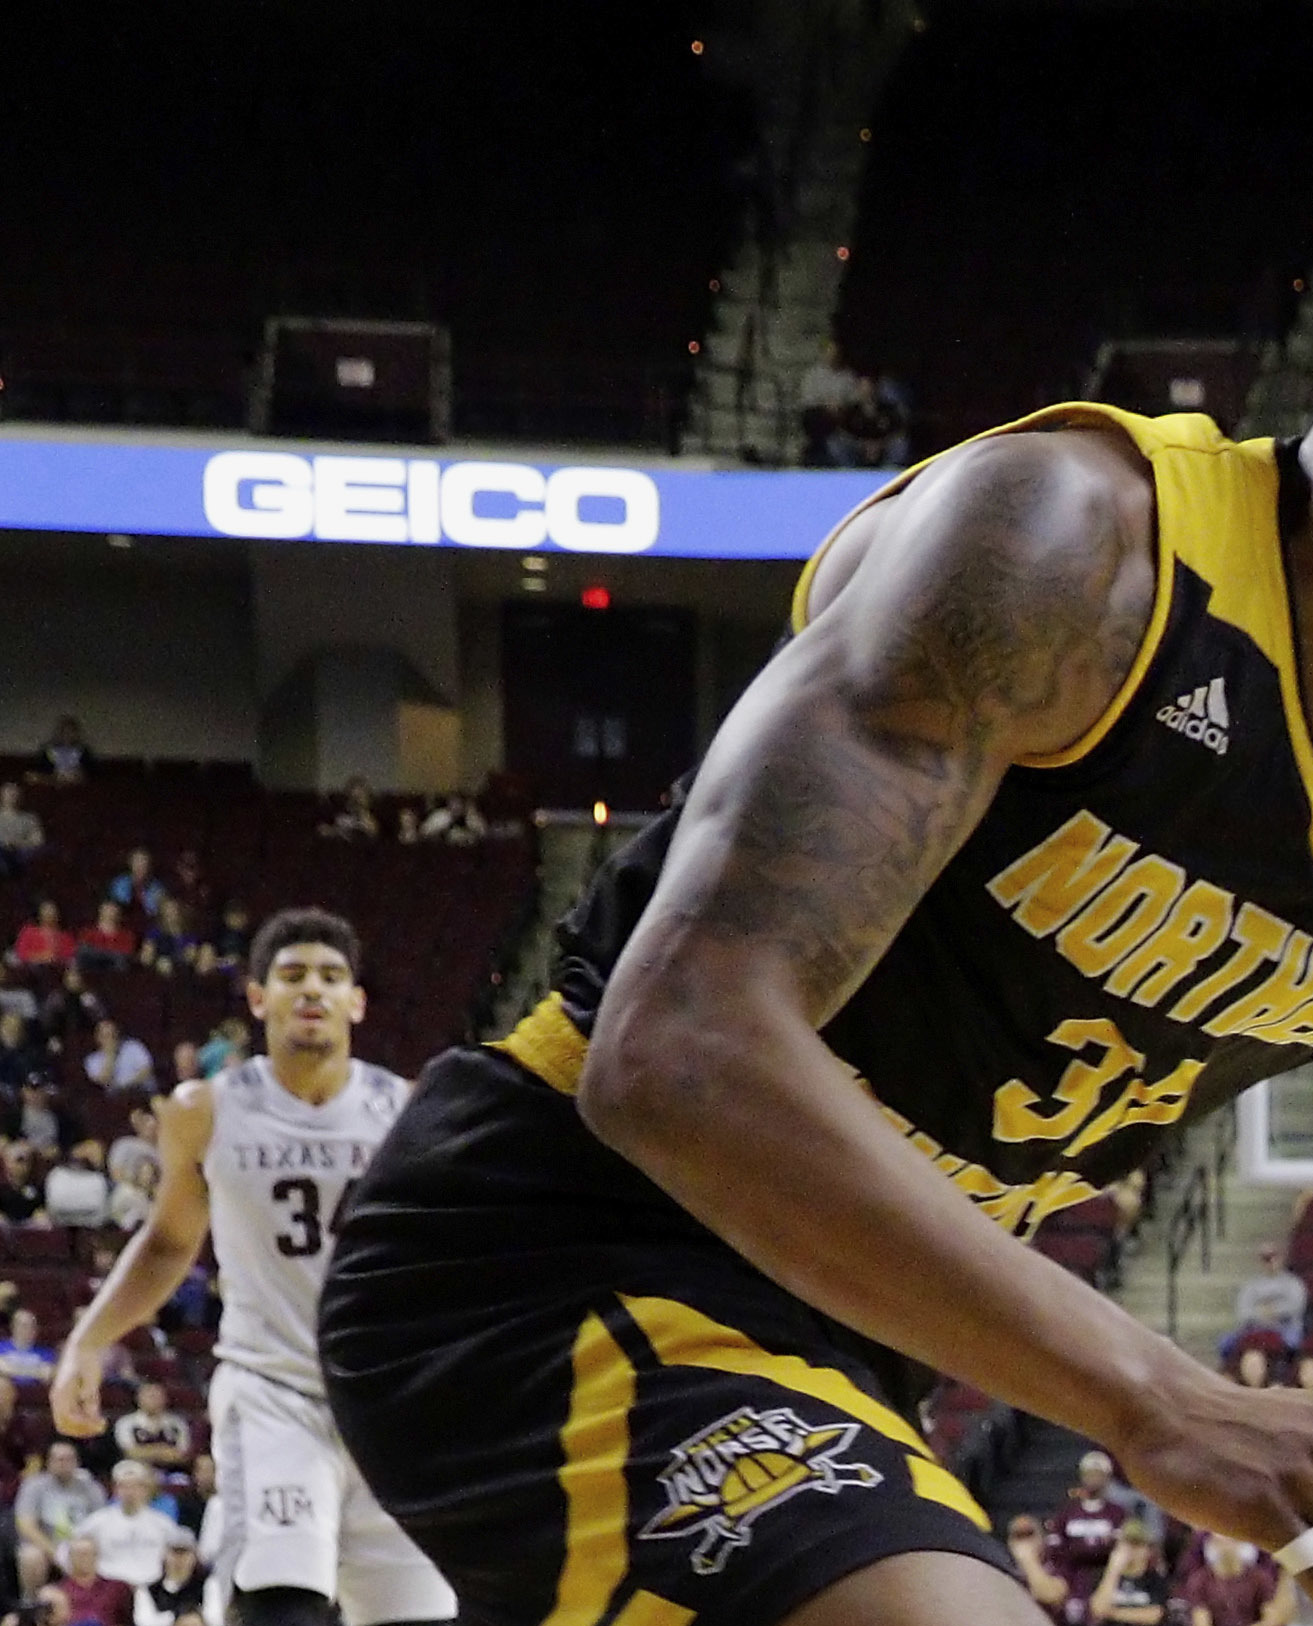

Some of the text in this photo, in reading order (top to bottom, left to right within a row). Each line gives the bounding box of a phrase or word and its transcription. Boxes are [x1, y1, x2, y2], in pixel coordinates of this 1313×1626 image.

[203, 451, 660, 554] GEICO
[1156, 705, 1230, 755] adidas
[234, 1142, 335, 1171] TEXAS
[672, 1412, 809, 1505] NORSE
